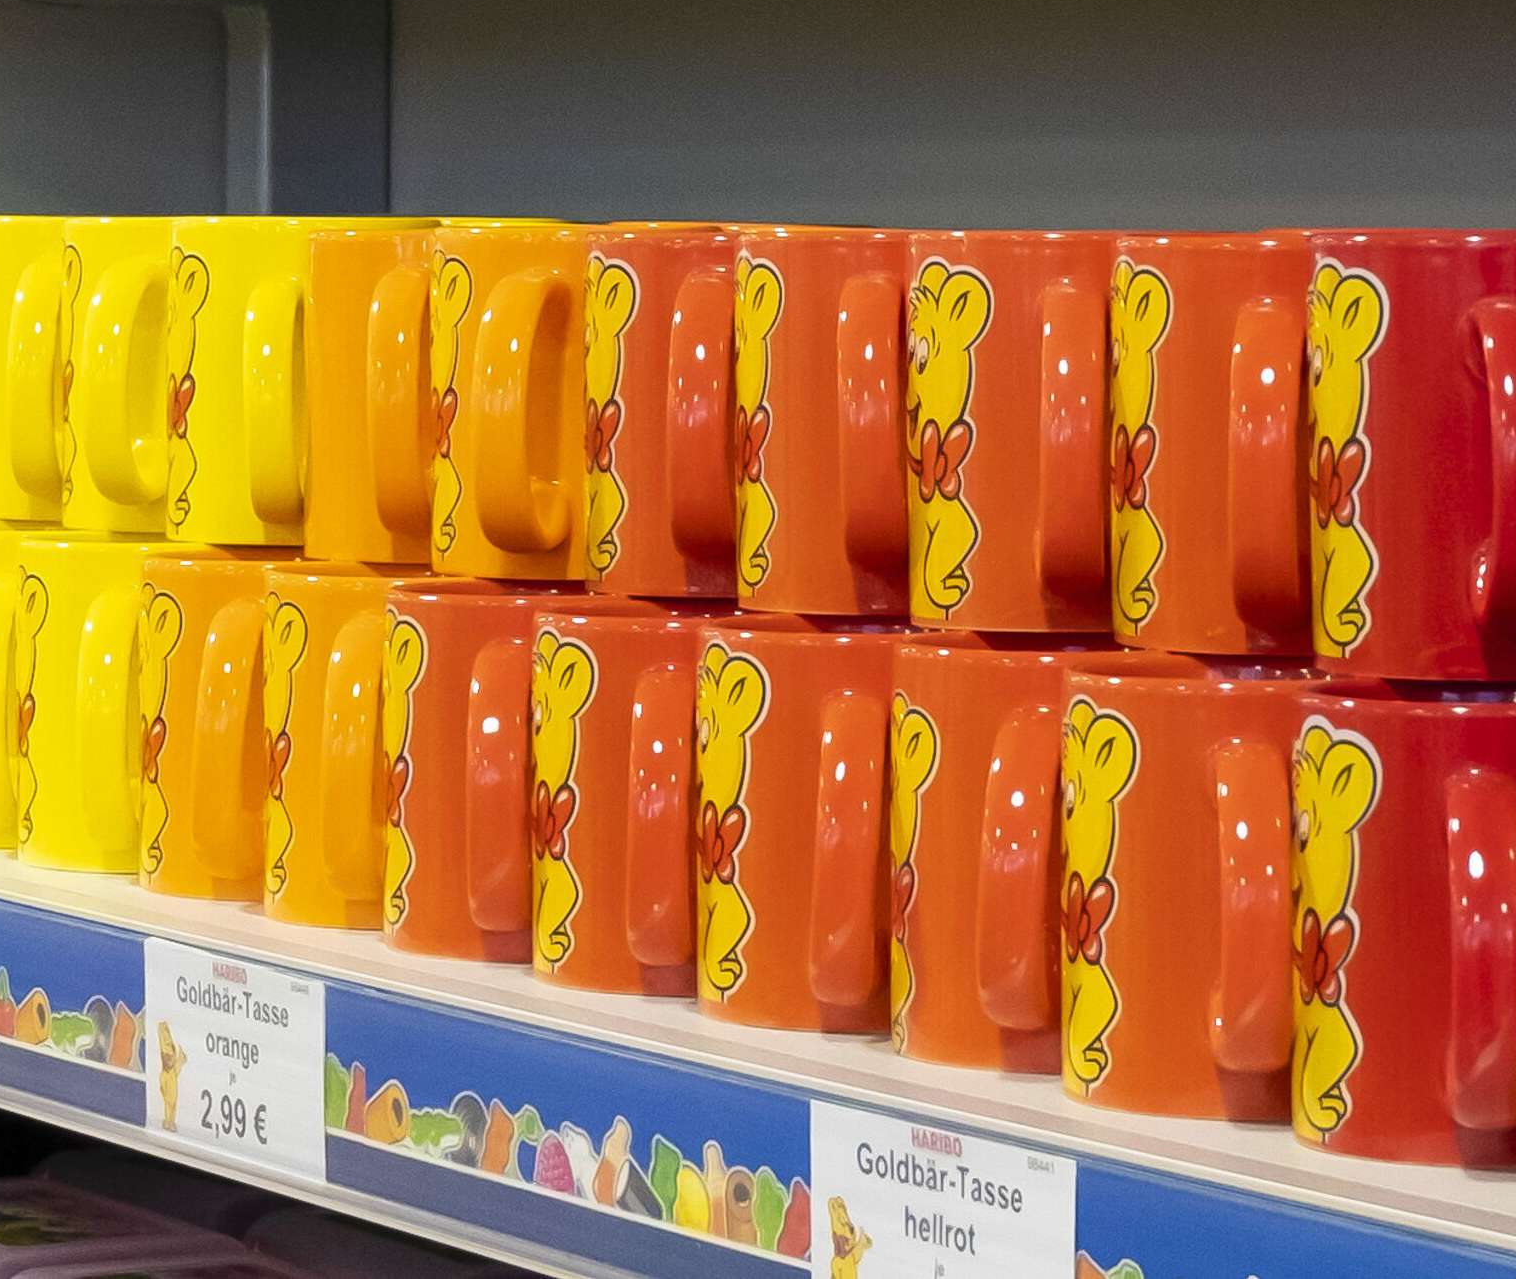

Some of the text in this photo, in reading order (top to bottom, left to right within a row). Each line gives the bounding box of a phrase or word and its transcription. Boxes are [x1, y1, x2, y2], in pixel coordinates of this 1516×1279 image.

[176, 976, 289, 1027] Goldbär-Tasse
[206, 1033, 259, 1069] orange
[201, 1089, 267, 1145] 2,99 €
[911, 1127, 963, 1158] HARIBO
[857, 1142, 1023, 1213] Goldbär-Tasse
[905, 1205, 976, 1256] hellrot
